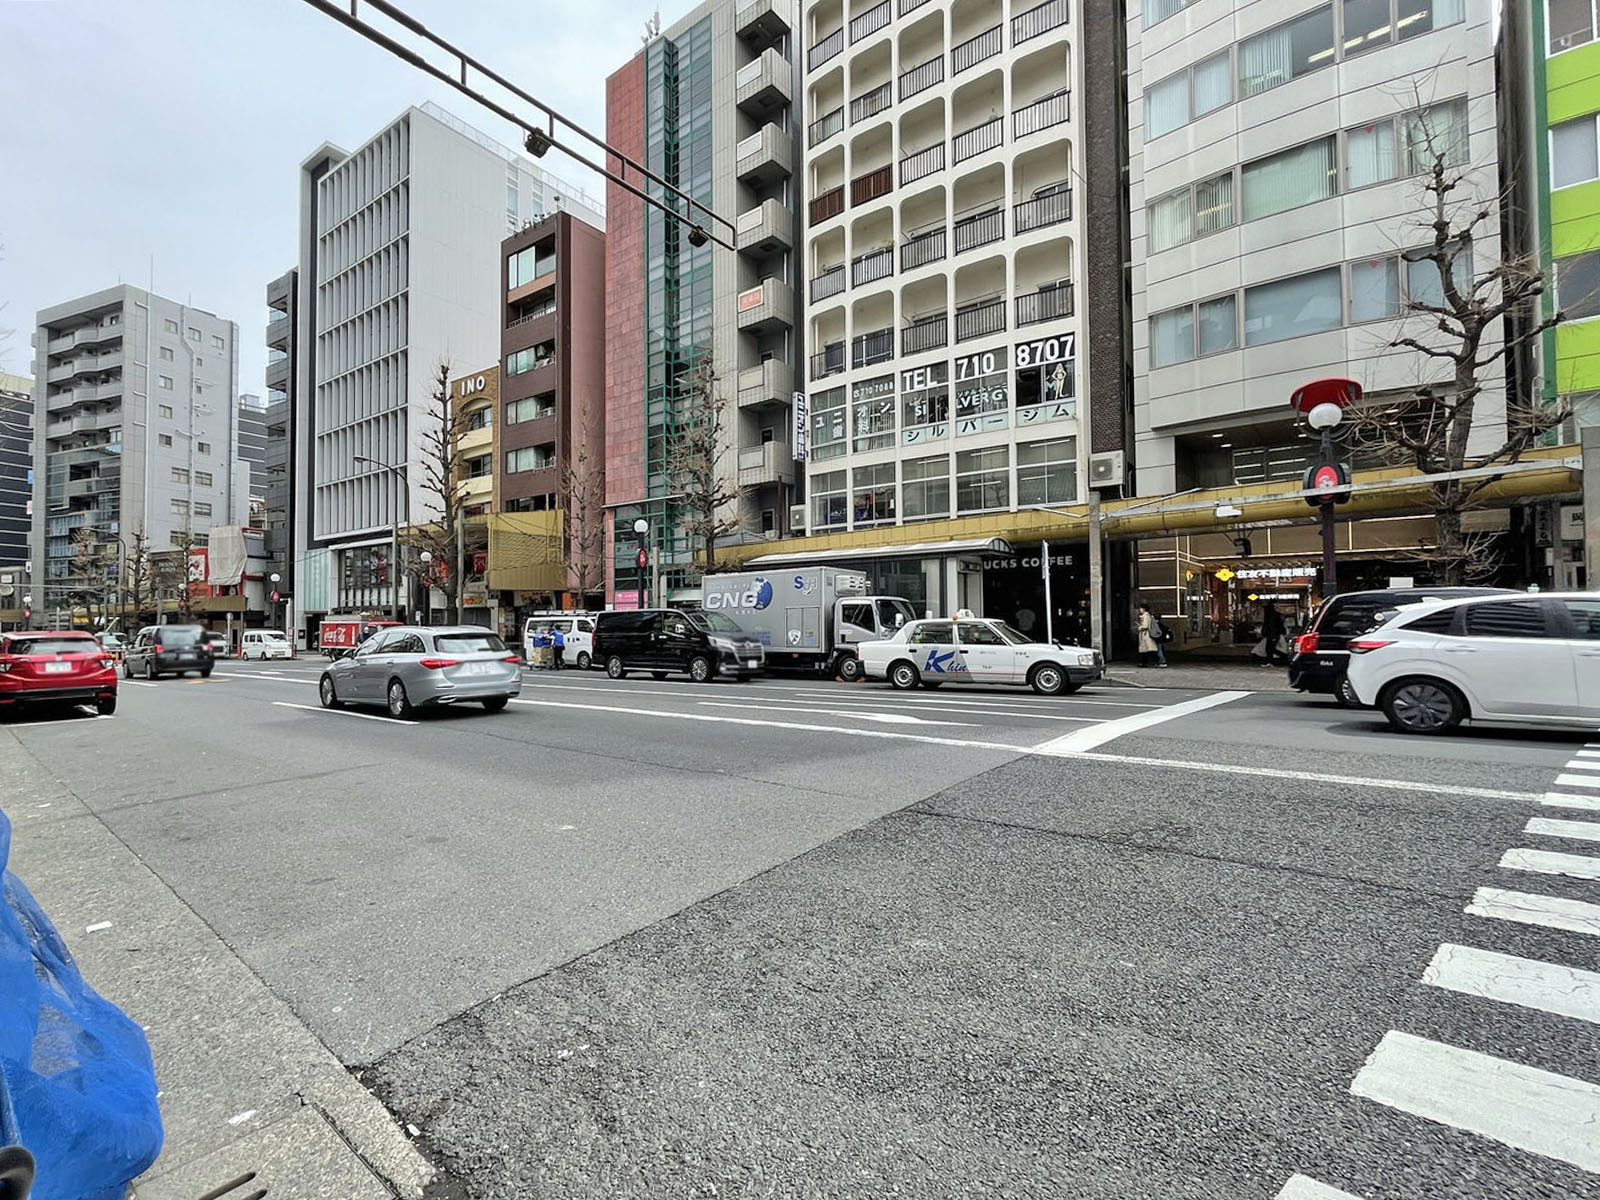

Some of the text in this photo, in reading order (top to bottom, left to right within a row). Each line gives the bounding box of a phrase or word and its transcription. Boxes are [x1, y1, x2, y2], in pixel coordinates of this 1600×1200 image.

[902, 335, 1074, 391] TEL 710 8707
[461, 375, 486, 396] INO
[907, 405, 1069, 442] シルバージム
[983, 556, 1073, 570] UCKS COFEE
[706, 591, 758, 609] CNG
